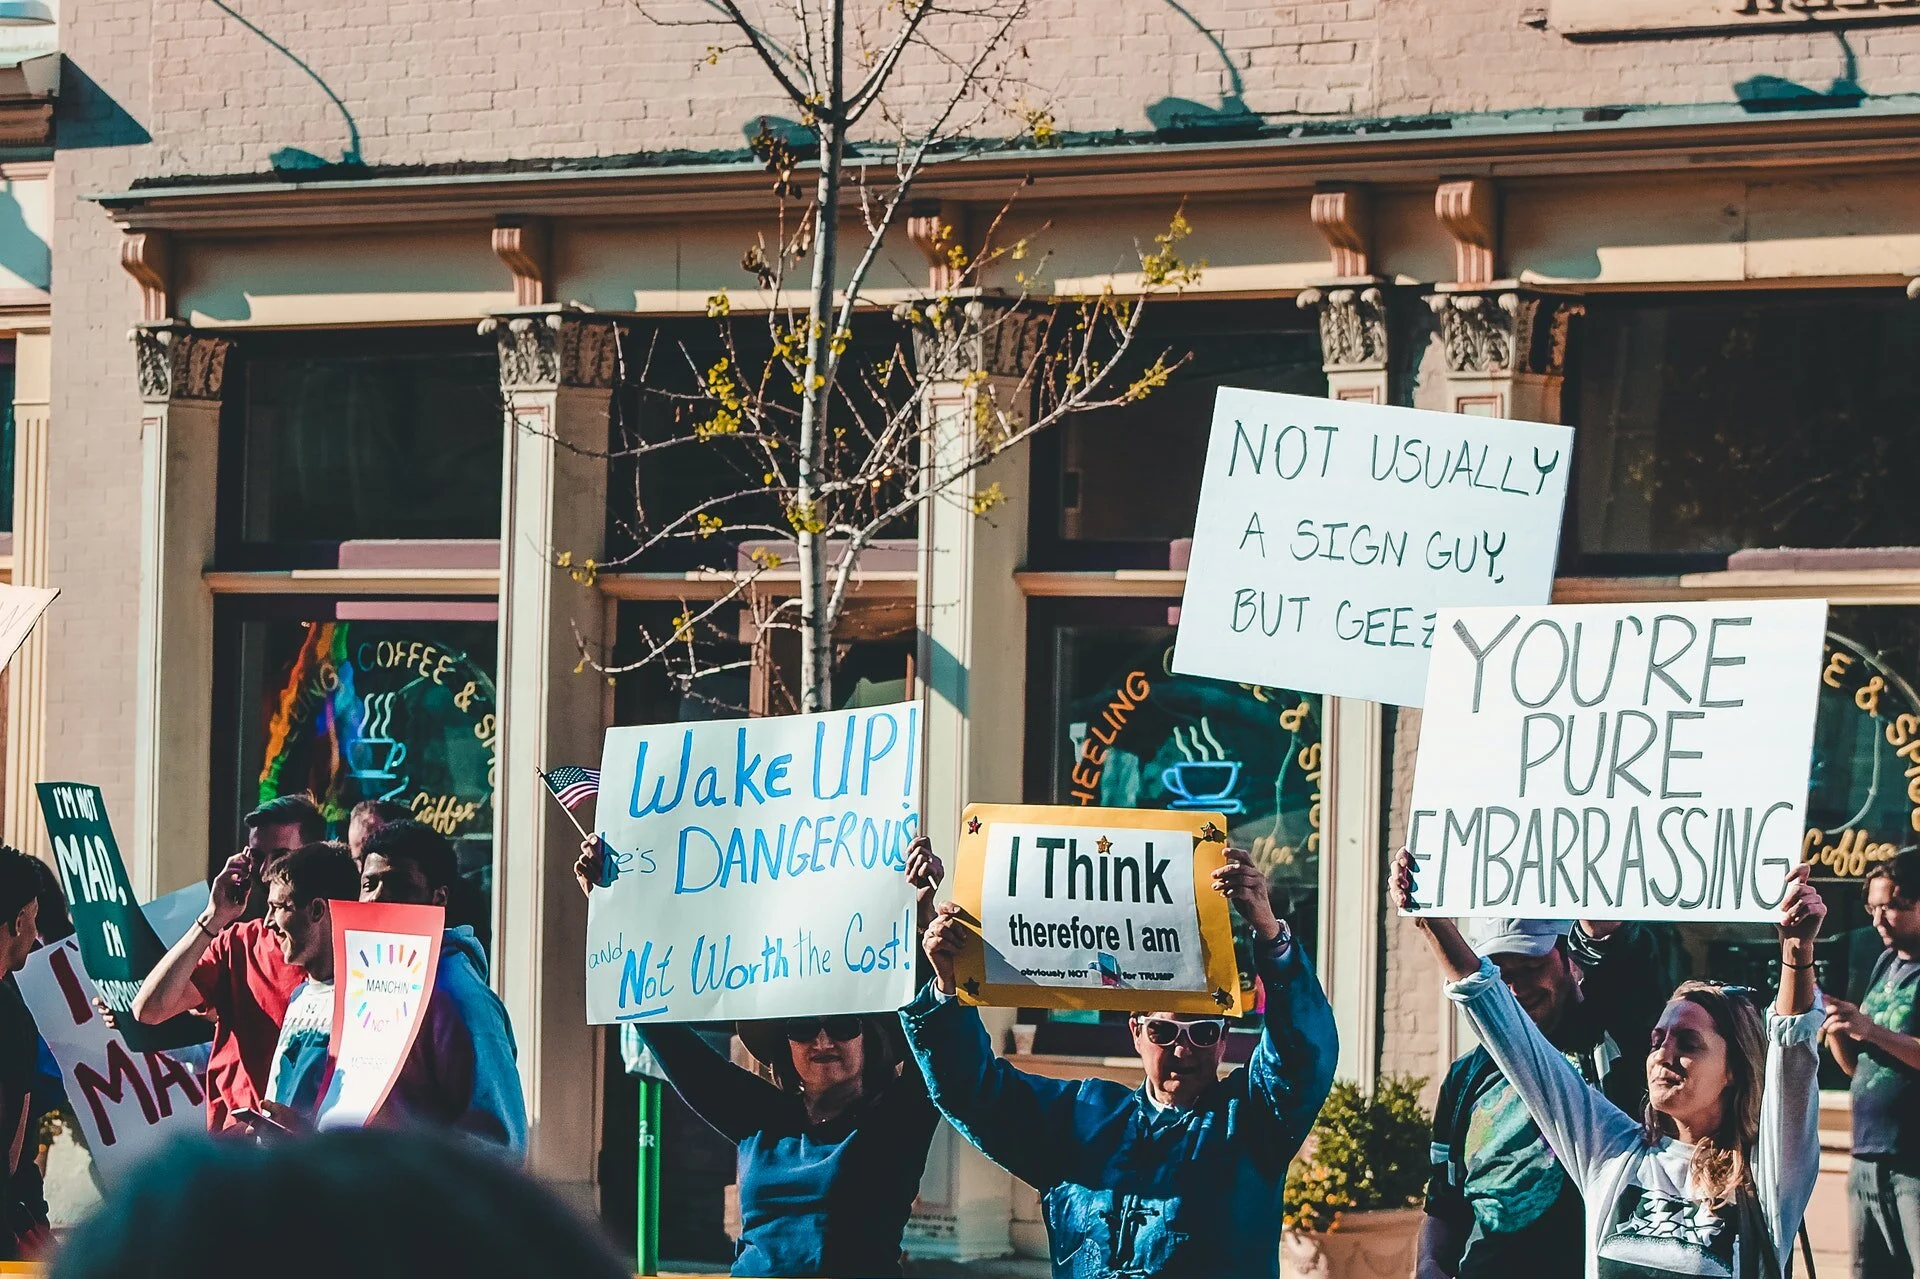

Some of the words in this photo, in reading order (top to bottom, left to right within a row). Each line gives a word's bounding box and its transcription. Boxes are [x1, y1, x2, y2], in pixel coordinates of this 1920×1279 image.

[1229, 420, 1339, 480] NOT
[1371, 433, 1559, 496] USUALLY
[1239, 512, 1266, 559] A
[1289, 520, 1408, 567] SIGN
[1425, 530, 1506, 584] GUY,
[1230, 588, 1310, 637] BUT
[358, 640, 456, 685] COFFEE
[454, 681, 476, 712] &
[1453, 614, 1752, 713] YOU'RE
[1855, 675, 1884, 718] &
[813, 708, 917, 809] UP!
[1519, 710, 1705, 799] PURE
[53, 786, 79, 819] I'M
[76, 787, 99, 822] NOT
[54, 834, 127, 906] MAD,
[674, 811, 918, 895] DANGEROUS
[1008, 836, 1021, 898] I
[1036, 835, 1174, 905] Think
[1409, 801, 1794, 910] EMBARRASSING
[1801, 828, 1897, 877] Coffee
[103, 920, 127, 958] I'M
[619, 941, 674, 1009] Not
[691, 934, 789, 994] Worth
[793, 927, 831, 979] the
[844, 910, 911, 973] Cost!
[1009, 913, 1120, 951] therefore
[1126, 918, 1135, 951] I
[1142, 927, 1181, 953] am
[366, 979, 410, 994] MANCHIN
[1021, 968, 1066, 979] obviously
[1068, 969, 1089, 979] NOT
[1122, 971, 1136, 980] for
[1138, 972, 1174, 981] TRUMP
